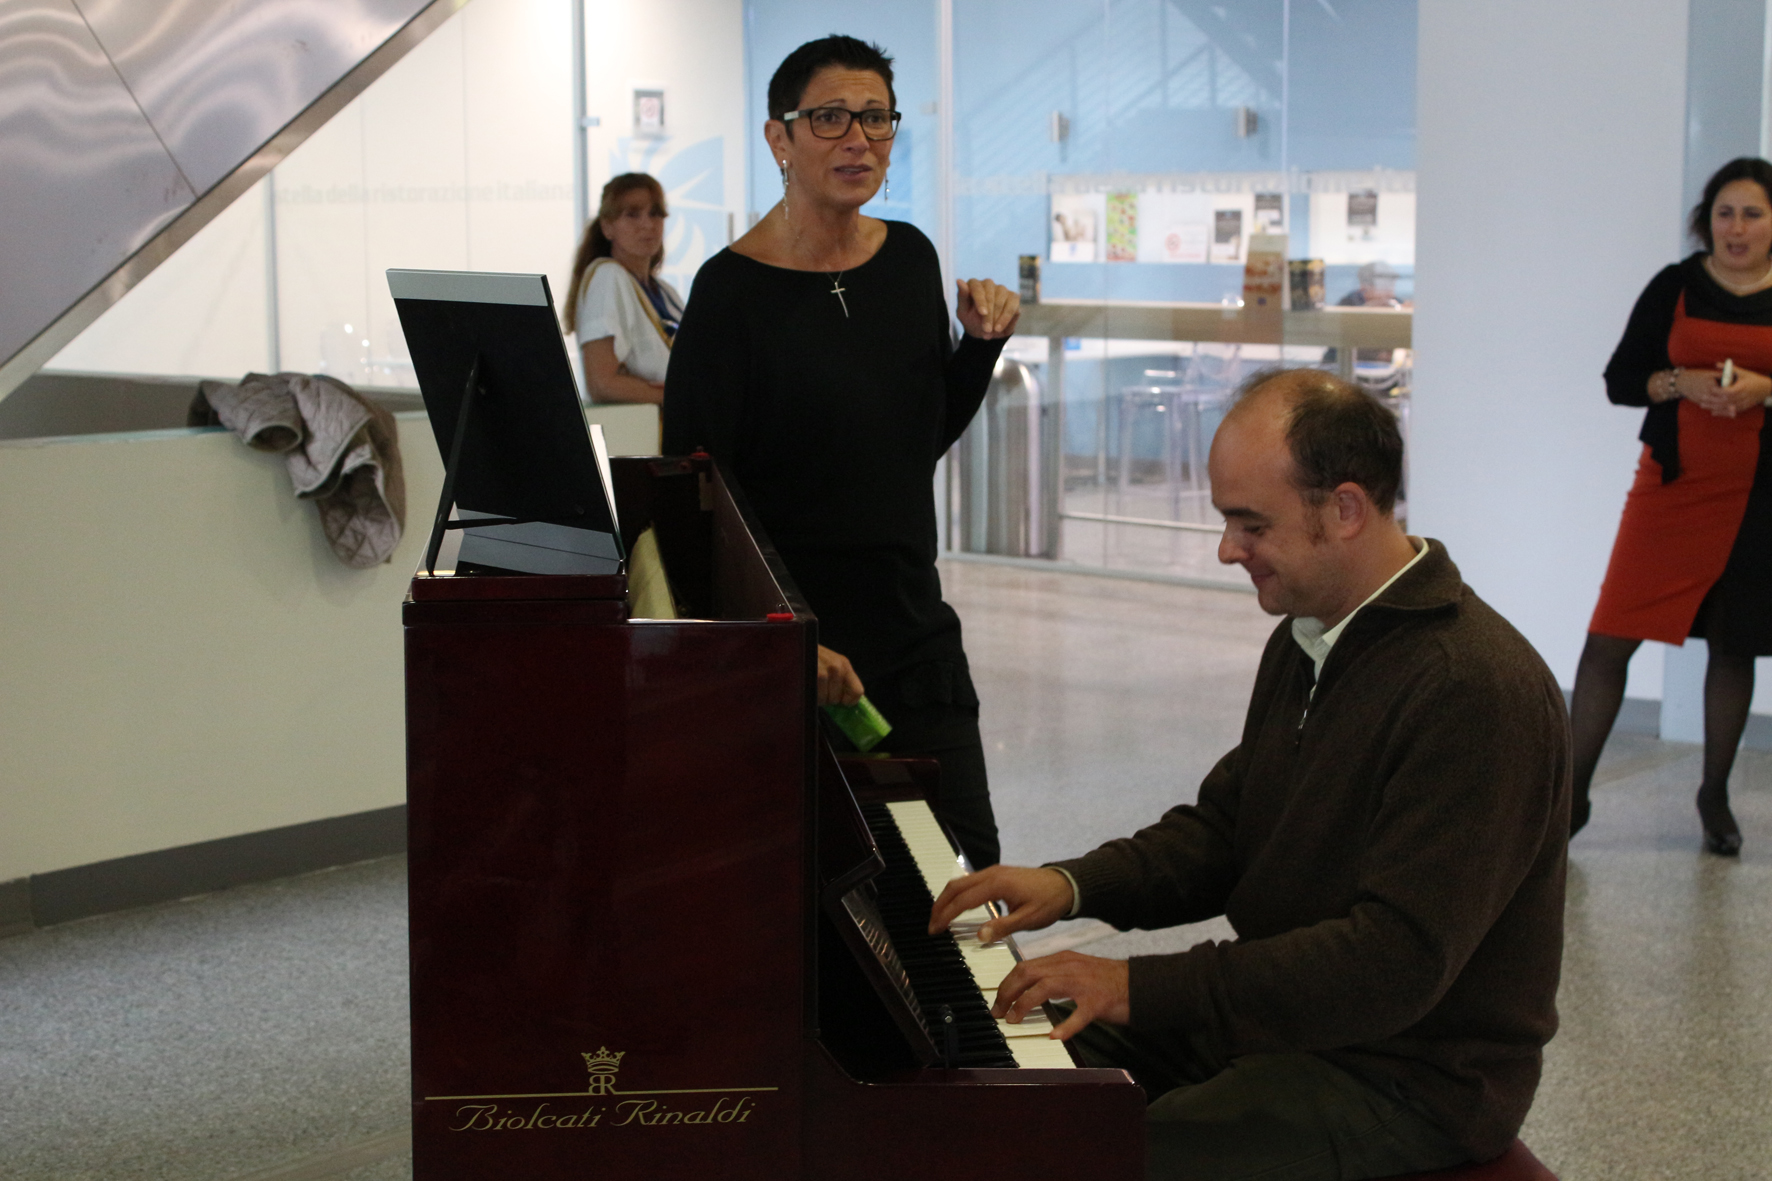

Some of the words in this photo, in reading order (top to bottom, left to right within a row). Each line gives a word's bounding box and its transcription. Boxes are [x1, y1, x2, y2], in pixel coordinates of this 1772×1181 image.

[373, 181, 494, 203] ristorazione
[448, 1102, 606, 1131] Biolcati
[609, 1096, 756, 1126] Rinaldi
